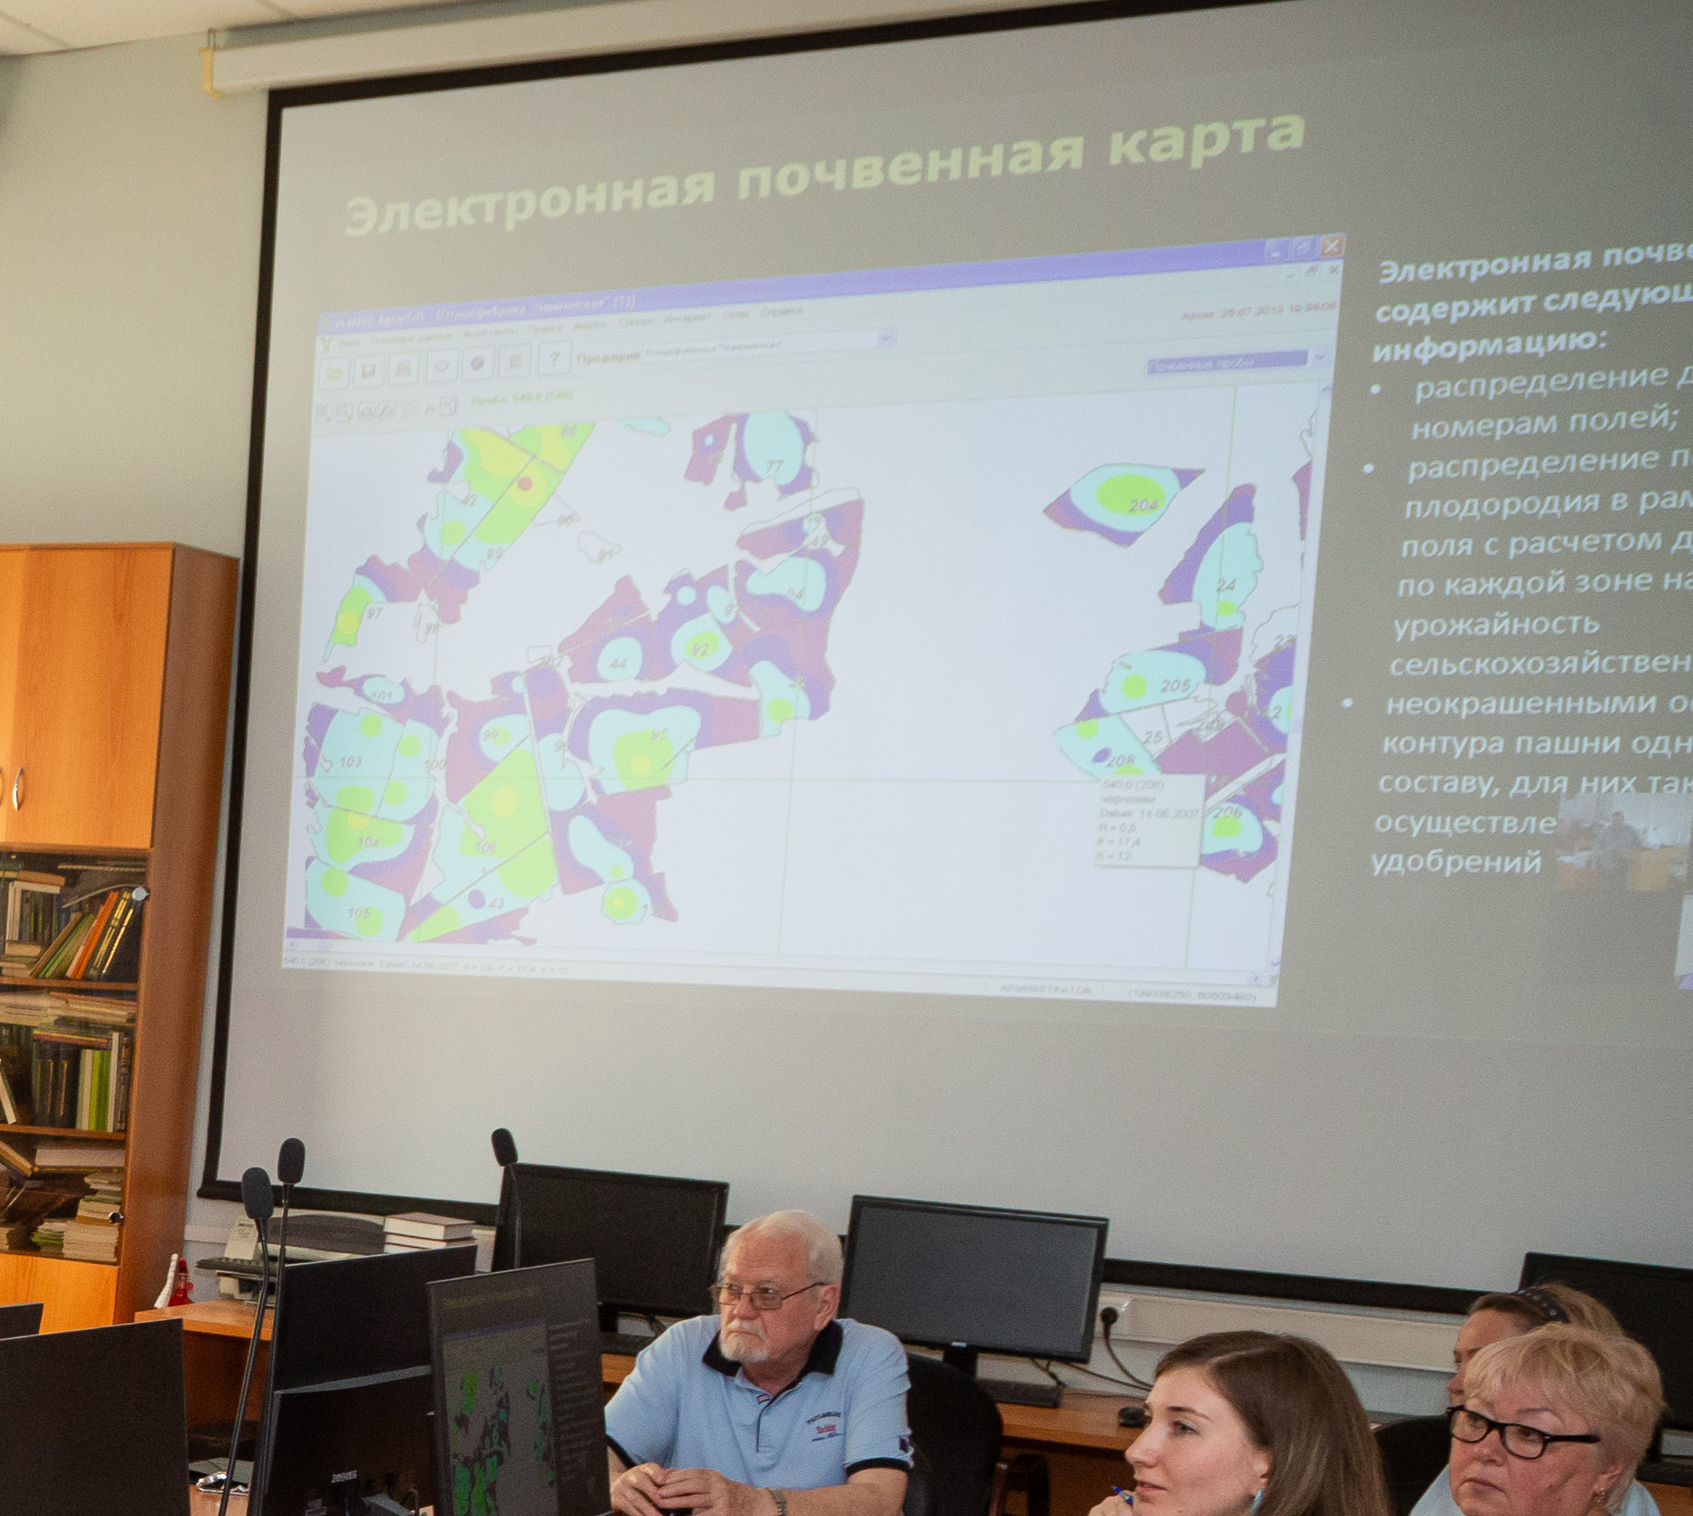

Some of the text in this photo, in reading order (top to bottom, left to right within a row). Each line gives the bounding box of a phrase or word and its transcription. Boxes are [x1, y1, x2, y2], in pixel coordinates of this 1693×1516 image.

[345, 113, 1307, 238] Электронная почвенная карта
[1378, 248, 1592, 284] Электронная
[1375, 293, 1537, 327] содержит
[1372, 329, 1609, 366] информацию:
[1415, 365, 1670, 404] распределение
[1411, 402, 1681, 442] номерам полей;
[766, 459, 784, 474] 77
[1408, 448, 1661, 485] распределение
[1128, 499, 1160, 513] 204
[1405, 491, 1601, 522] плодородия
[1611, 492, 1628, 512] в
[1401, 535, 1473, 559] поля
[1485, 537, 1499, 557] с
[1508, 531, 1663, 560] расчетом
[1216, 578, 1237, 593] 24
[1397, 577, 1435, 598] по
[1444, 569, 1566, 600] каждой
[1574, 572, 1654, 594] зоне
[1392, 611, 1601, 642] урожайность
[1160, 679, 1192, 694] 205
[1386, 694, 1657, 719] неокрашенными
[1143, 730, 1164, 745] 25
[1382, 734, 1505, 760] контура
[1514, 734, 1621, 756] пашни
[339, 755, 363, 769] 103
[1378, 774, 1501, 799] составу,
[1509, 775, 1570, 799] для
[1580, 775, 1638, 795] них
[1213, 806, 1243, 820] 206
[357, 835, 381, 849] 104
[1370, 848, 1543, 877] удобрений
[347, 906, 372, 920] 105
